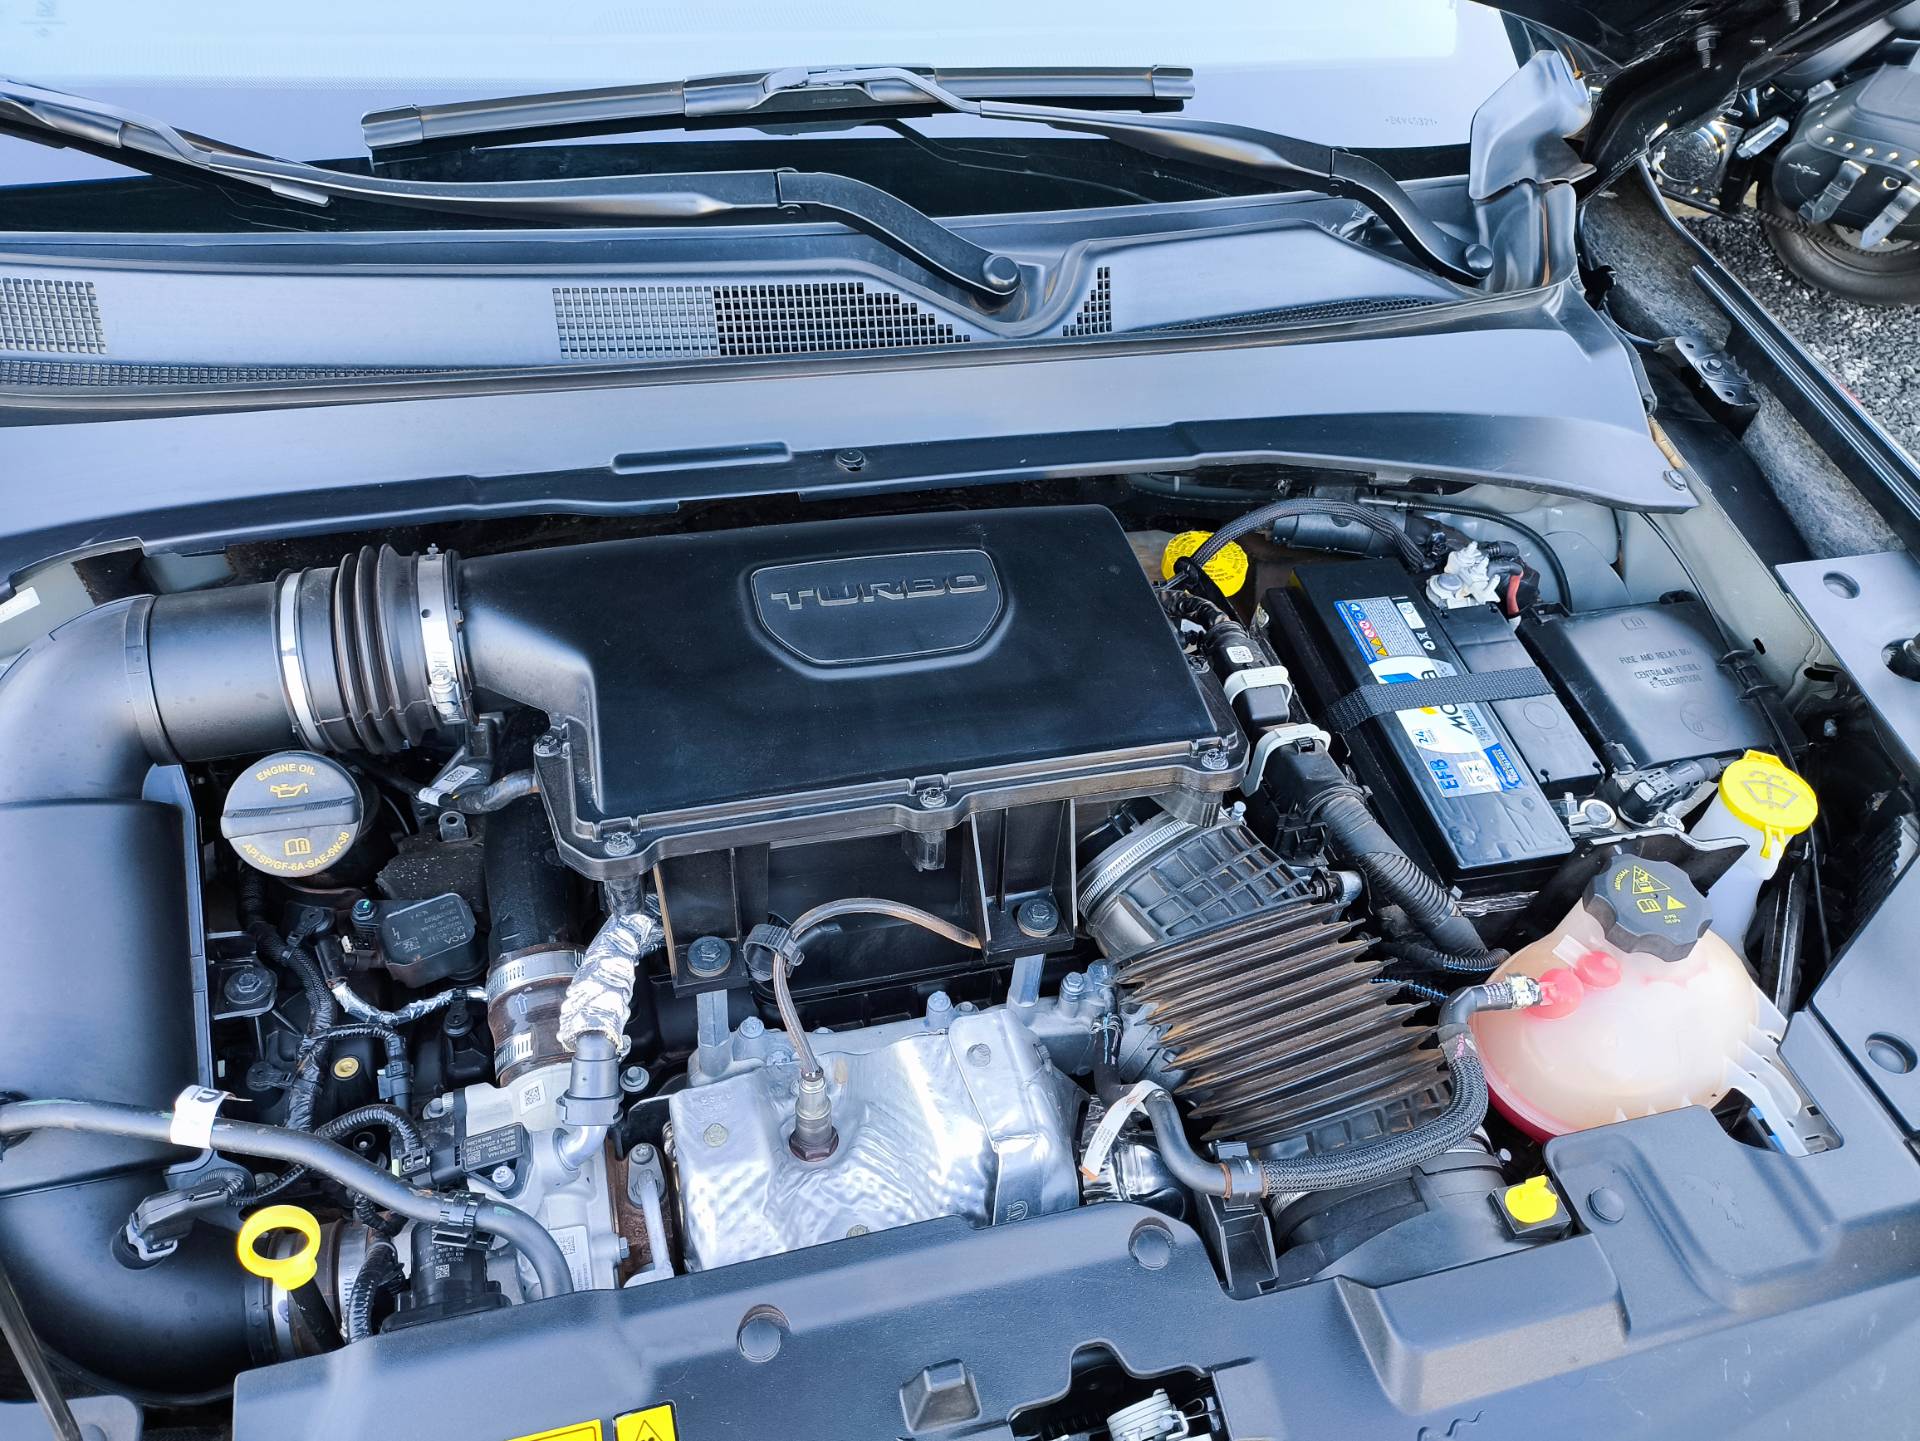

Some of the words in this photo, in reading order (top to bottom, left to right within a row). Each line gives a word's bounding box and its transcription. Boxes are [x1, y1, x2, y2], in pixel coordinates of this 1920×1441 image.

[770, 575, 988, 610] TURBO
[255, 763, 297, 782] ENGINE
[298, 764, 316, 776] OIL
[1429, 758, 1460, 790] EFB
